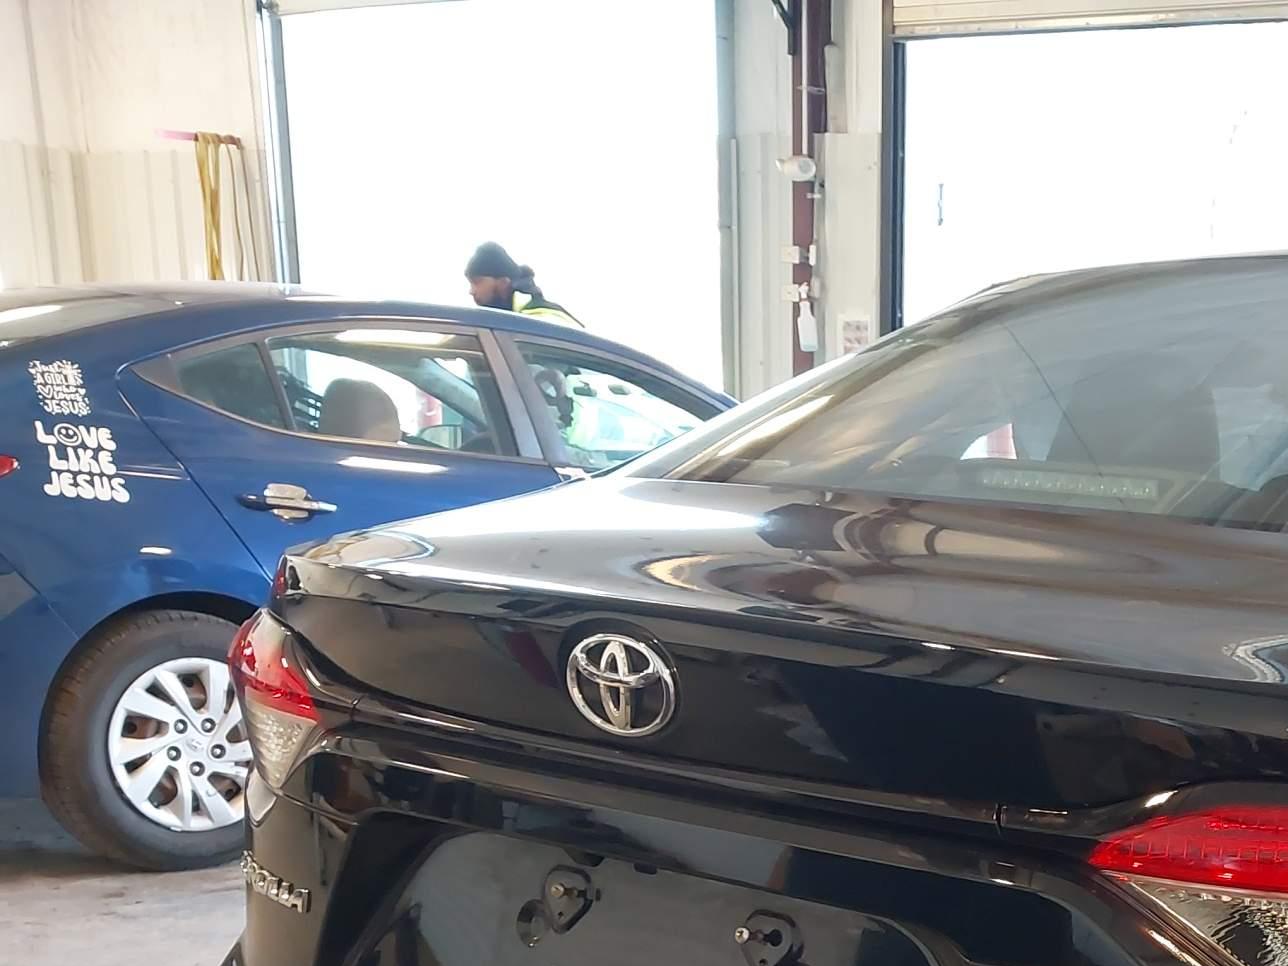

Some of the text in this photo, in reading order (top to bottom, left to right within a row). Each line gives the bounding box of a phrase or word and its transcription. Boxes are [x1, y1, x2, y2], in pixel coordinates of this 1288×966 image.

[44, 400, 88, 415] JESUS
[34, 421, 117, 450] LOVE
[48, 446, 117, 475] LIKE
[43, 471, 130, 503] JESUS
